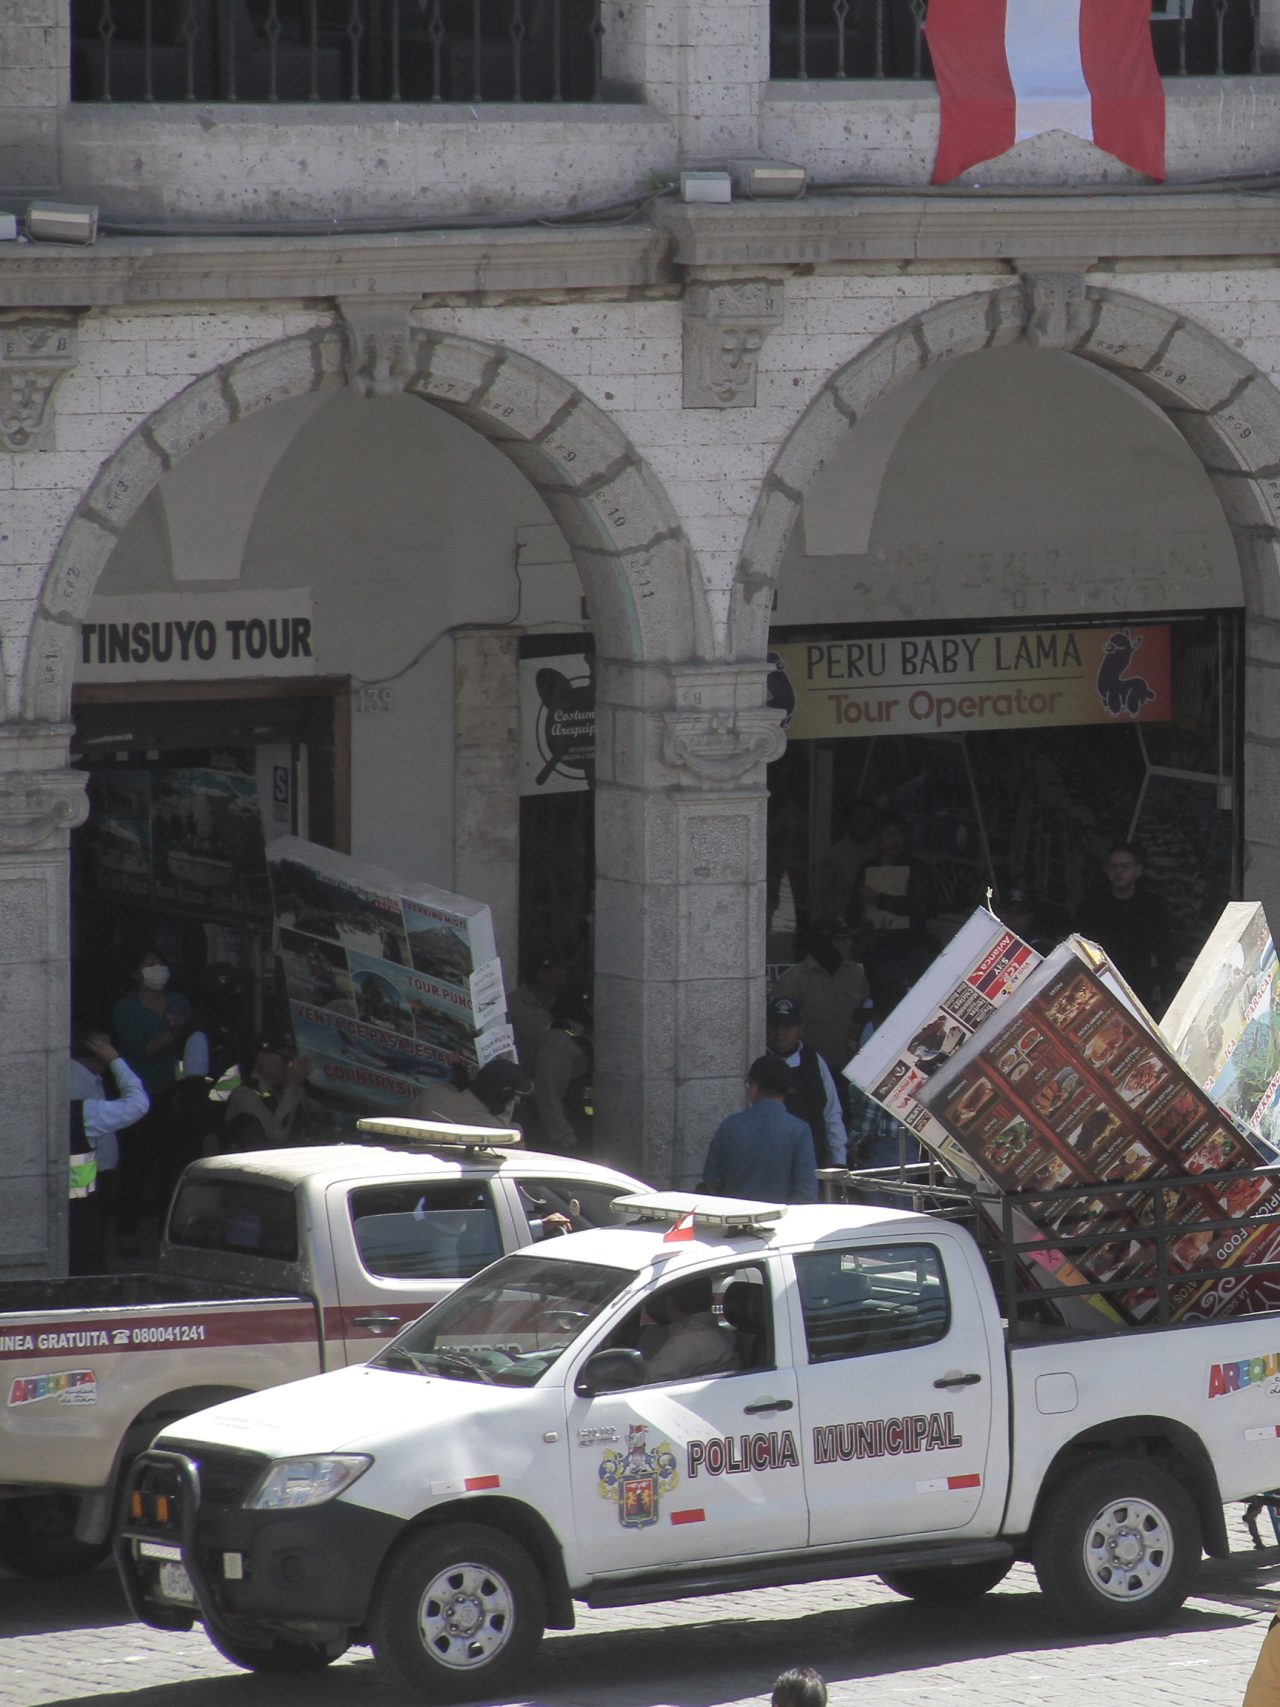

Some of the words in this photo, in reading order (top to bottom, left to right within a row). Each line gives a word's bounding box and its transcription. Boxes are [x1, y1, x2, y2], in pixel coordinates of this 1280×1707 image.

[82, 619, 216, 664] TINSUYO
[226, 616, 313, 660] TOUR
[806, 641, 887, 681] PERU
[901, 637, 981, 677] BABY
[995, 632, 1083, 671] LAMA
[828, 690, 898, 726] Tour
[909, 687, 1064, 728] Operator
[975, 935, 1014, 971] Avianca
[403, 974, 440, 996] TOUR
[951, 986, 975, 1009] Chiclayo
[1238, 970, 1280, 1023] PARACAS
[973, 1003, 994, 1023] Trujillo
[346, 1021, 368, 1037] DE
[366, 1028, 435, 1059] PASAJES
[1213, 1226, 1249, 1262] FOOD
[38, 1329, 109, 1349] GRATUITA
[133, 1325, 206, 1343] 080041241
[11, 1370, 97, 1405] AREQUIPA
[687, 1430, 799, 1478] POLICIA
[812, 1411, 963, 1465] MUNICIPAL
